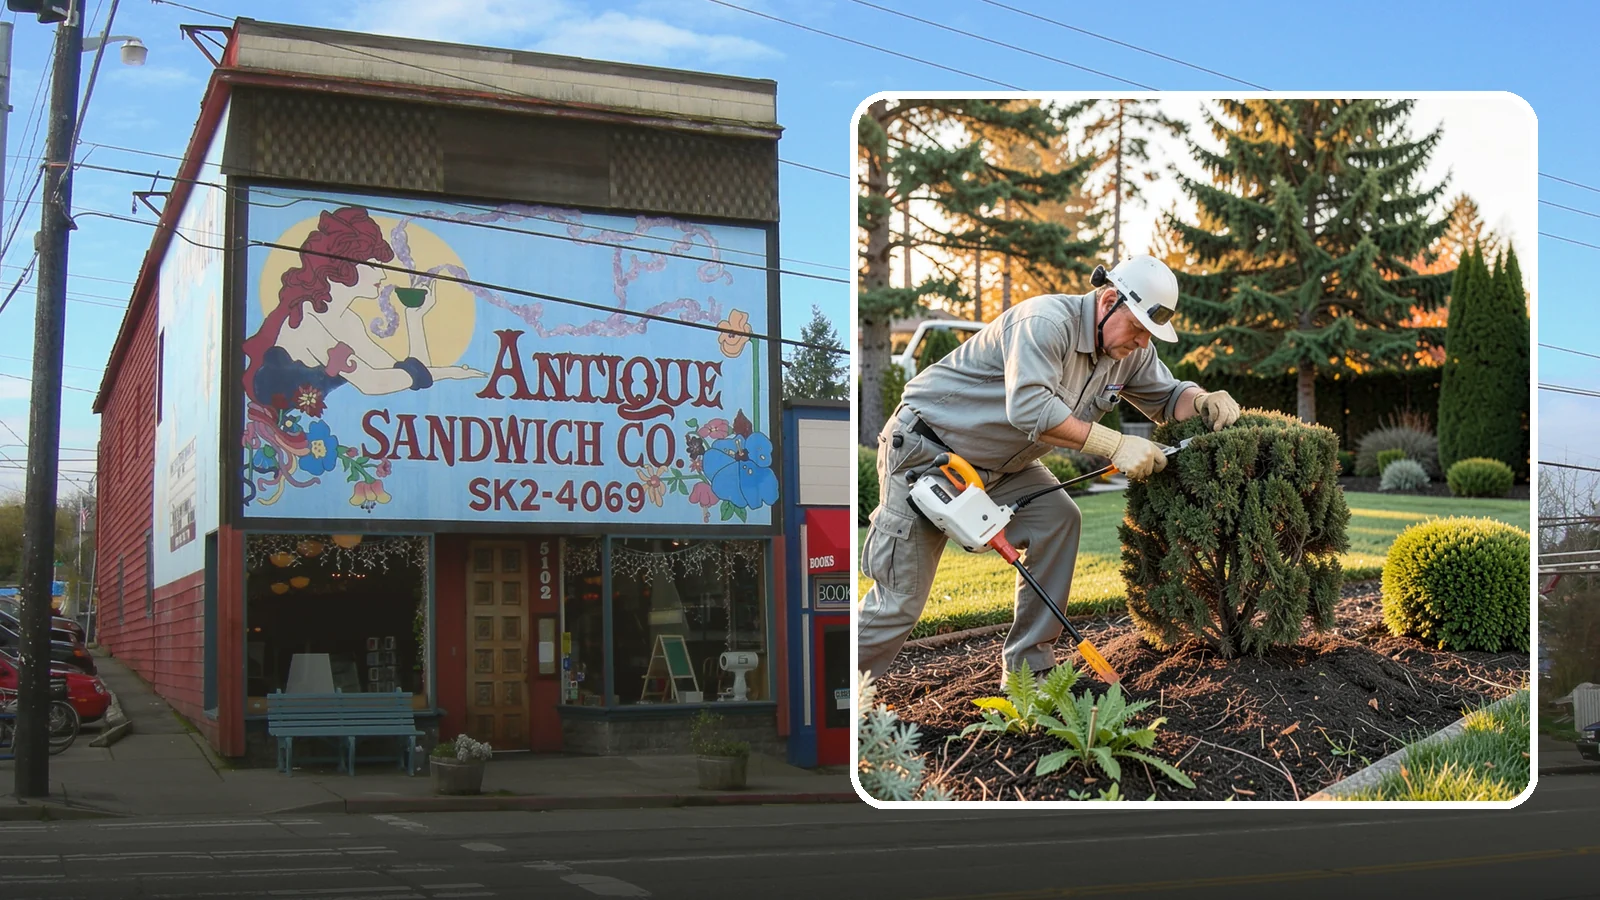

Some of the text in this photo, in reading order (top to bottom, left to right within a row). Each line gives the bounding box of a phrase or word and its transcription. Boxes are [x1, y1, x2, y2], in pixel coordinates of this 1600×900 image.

[475, 329, 724, 421] ANTIQUE
[361, 408, 685, 469] SANDWICH CO.
[468, 477, 646, 513] SK2-4069
[540, 542, 552, 600] 5102
[809, 555, 835, 569] BOOKS
